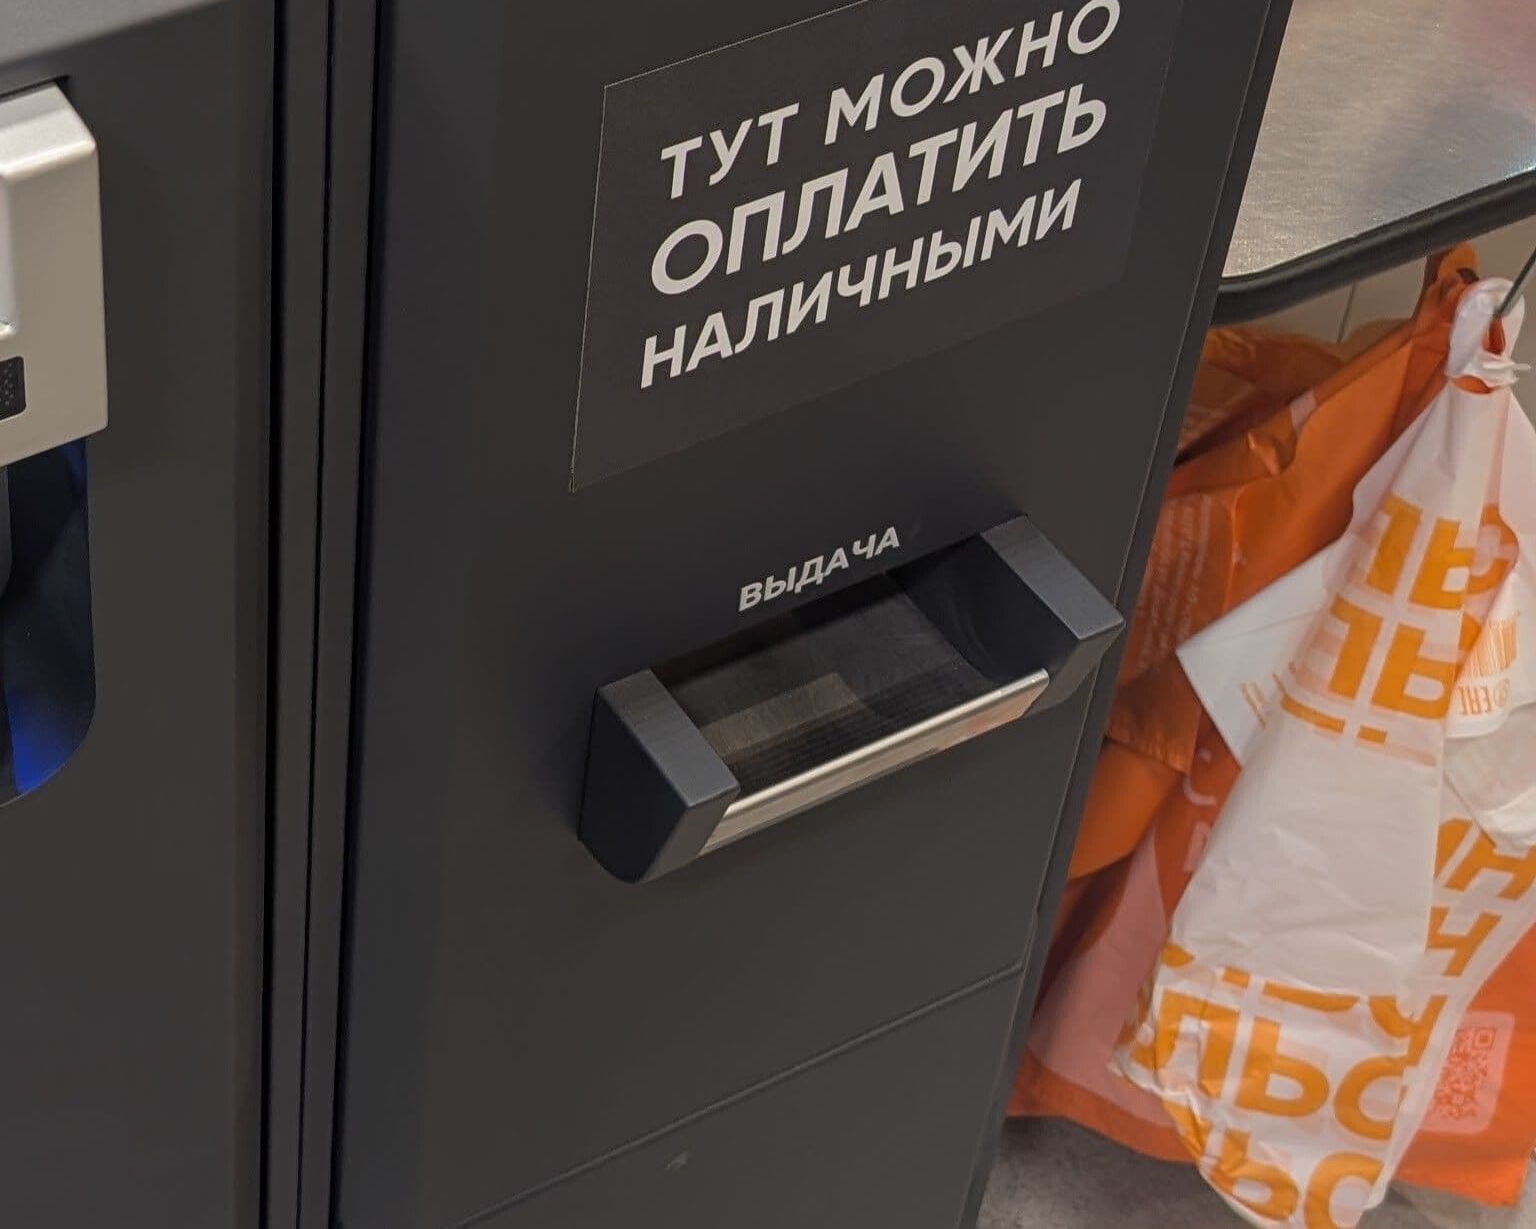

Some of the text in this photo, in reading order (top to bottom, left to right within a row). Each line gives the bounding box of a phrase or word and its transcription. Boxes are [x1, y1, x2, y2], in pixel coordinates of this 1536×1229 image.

[651, 83, 1107, 295] ОПЛАТИТЬ
[661, 103, 800, 199] ТУТ
[640, 178, 1082, 389] НАЛИЧНЫМИ
[738, 526, 900, 612] ВЫДАЧА
